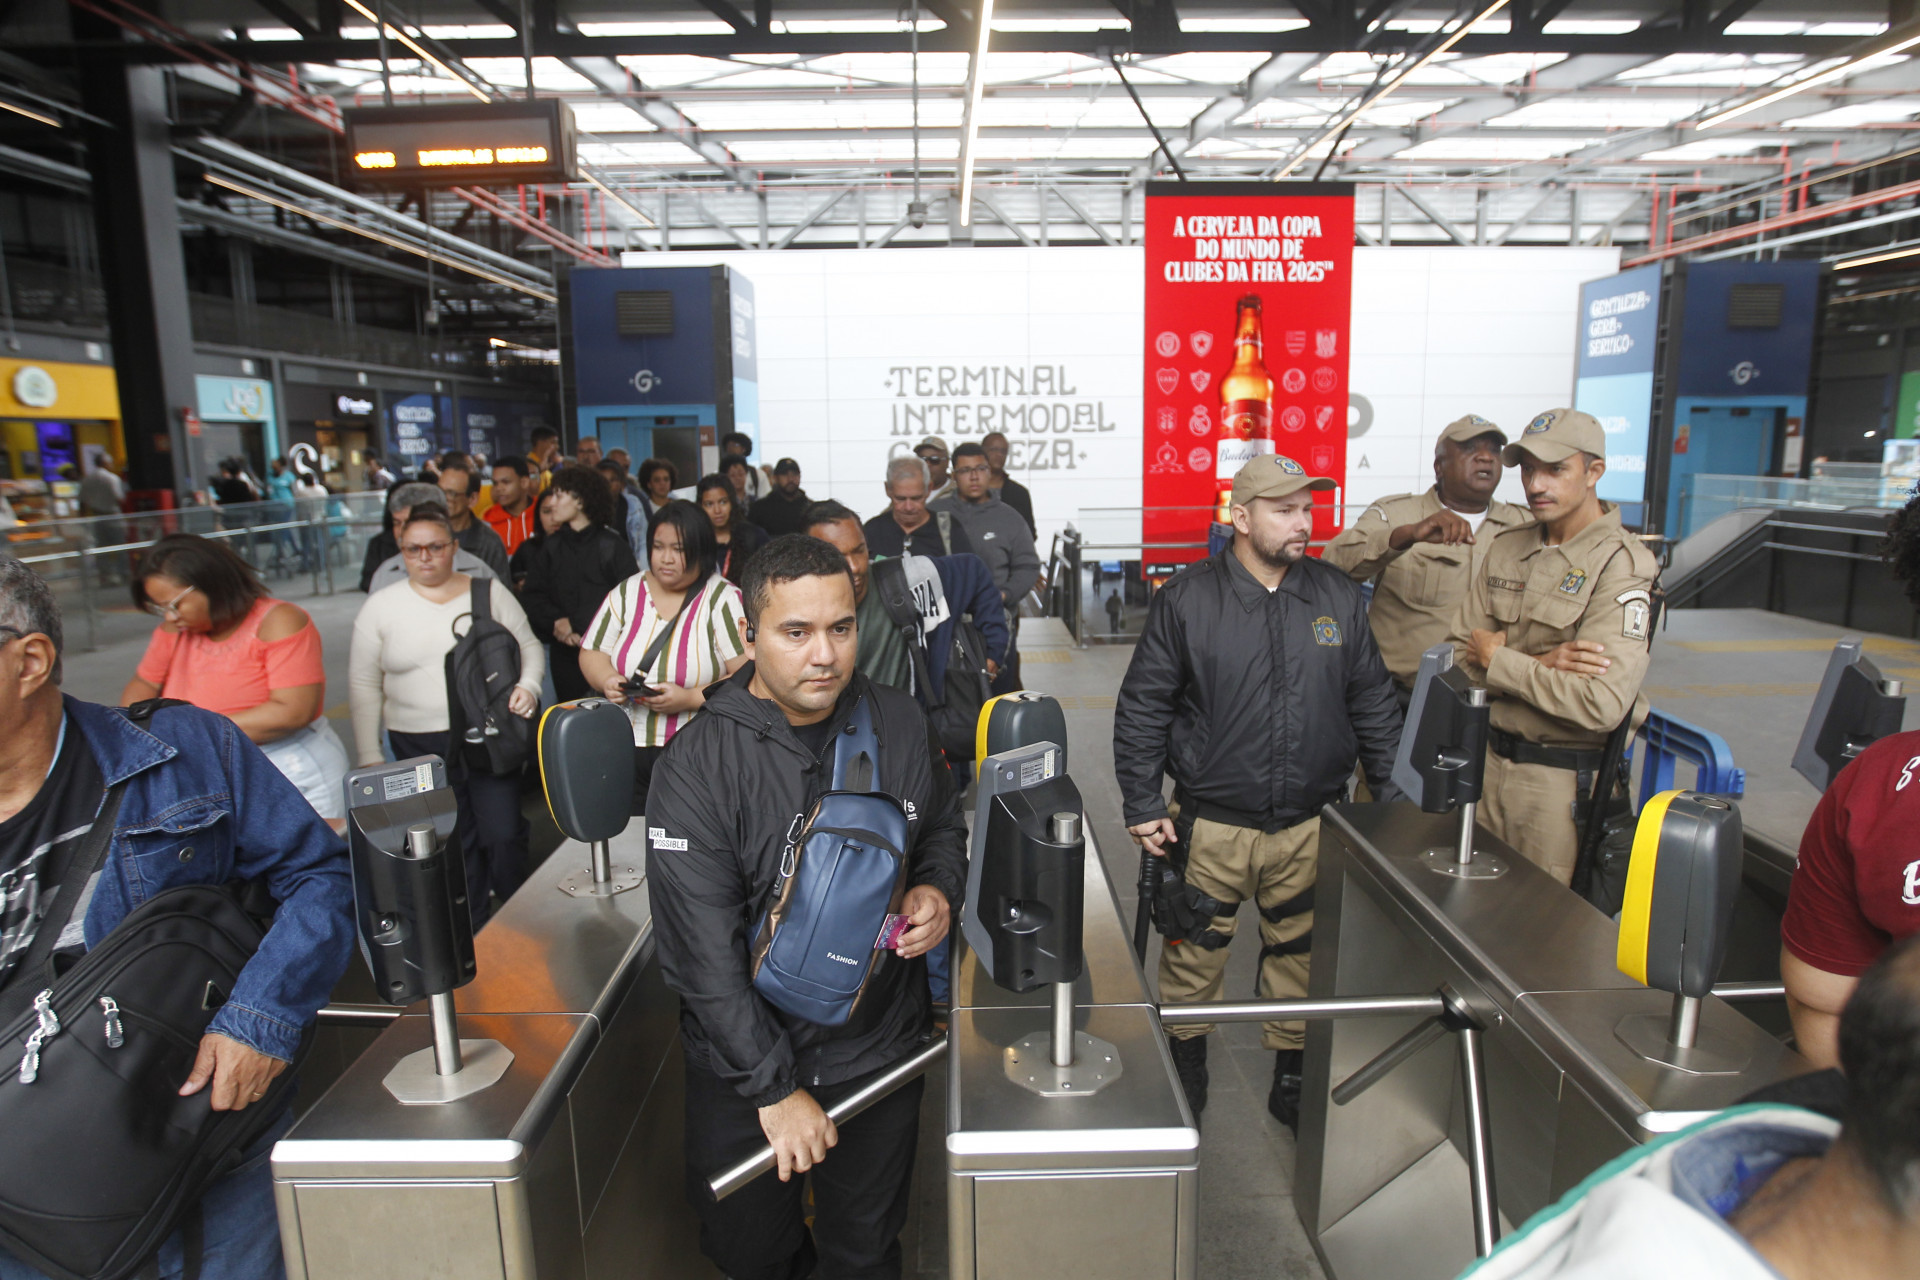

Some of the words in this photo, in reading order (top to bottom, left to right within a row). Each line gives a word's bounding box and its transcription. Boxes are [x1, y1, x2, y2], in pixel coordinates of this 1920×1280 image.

[1173, 216, 1186, 237] A
[1187, 216, 1255, 237] CERVEJA
[1257, 216, 1280, 237] DA
[1281, 216, 1322, 237] COPA
[1195, 239, 1219, 260] DO
[1221, 239, 1280, 260] MUNDO
[1281, 239, 1304, 260] DE
[1164, 261, 1224, 282] CLUBES
[1226, 261, 1249, 282] DA
[1252, 261, 1285, 282] FIFA
[890, 365, 1076, 397] TERMINAL
[890, 402, 1116, 436] INTERMODAL
[654, 838, 686, 849] POSSIBLE
[826, 952, 858, 965] FASHION
